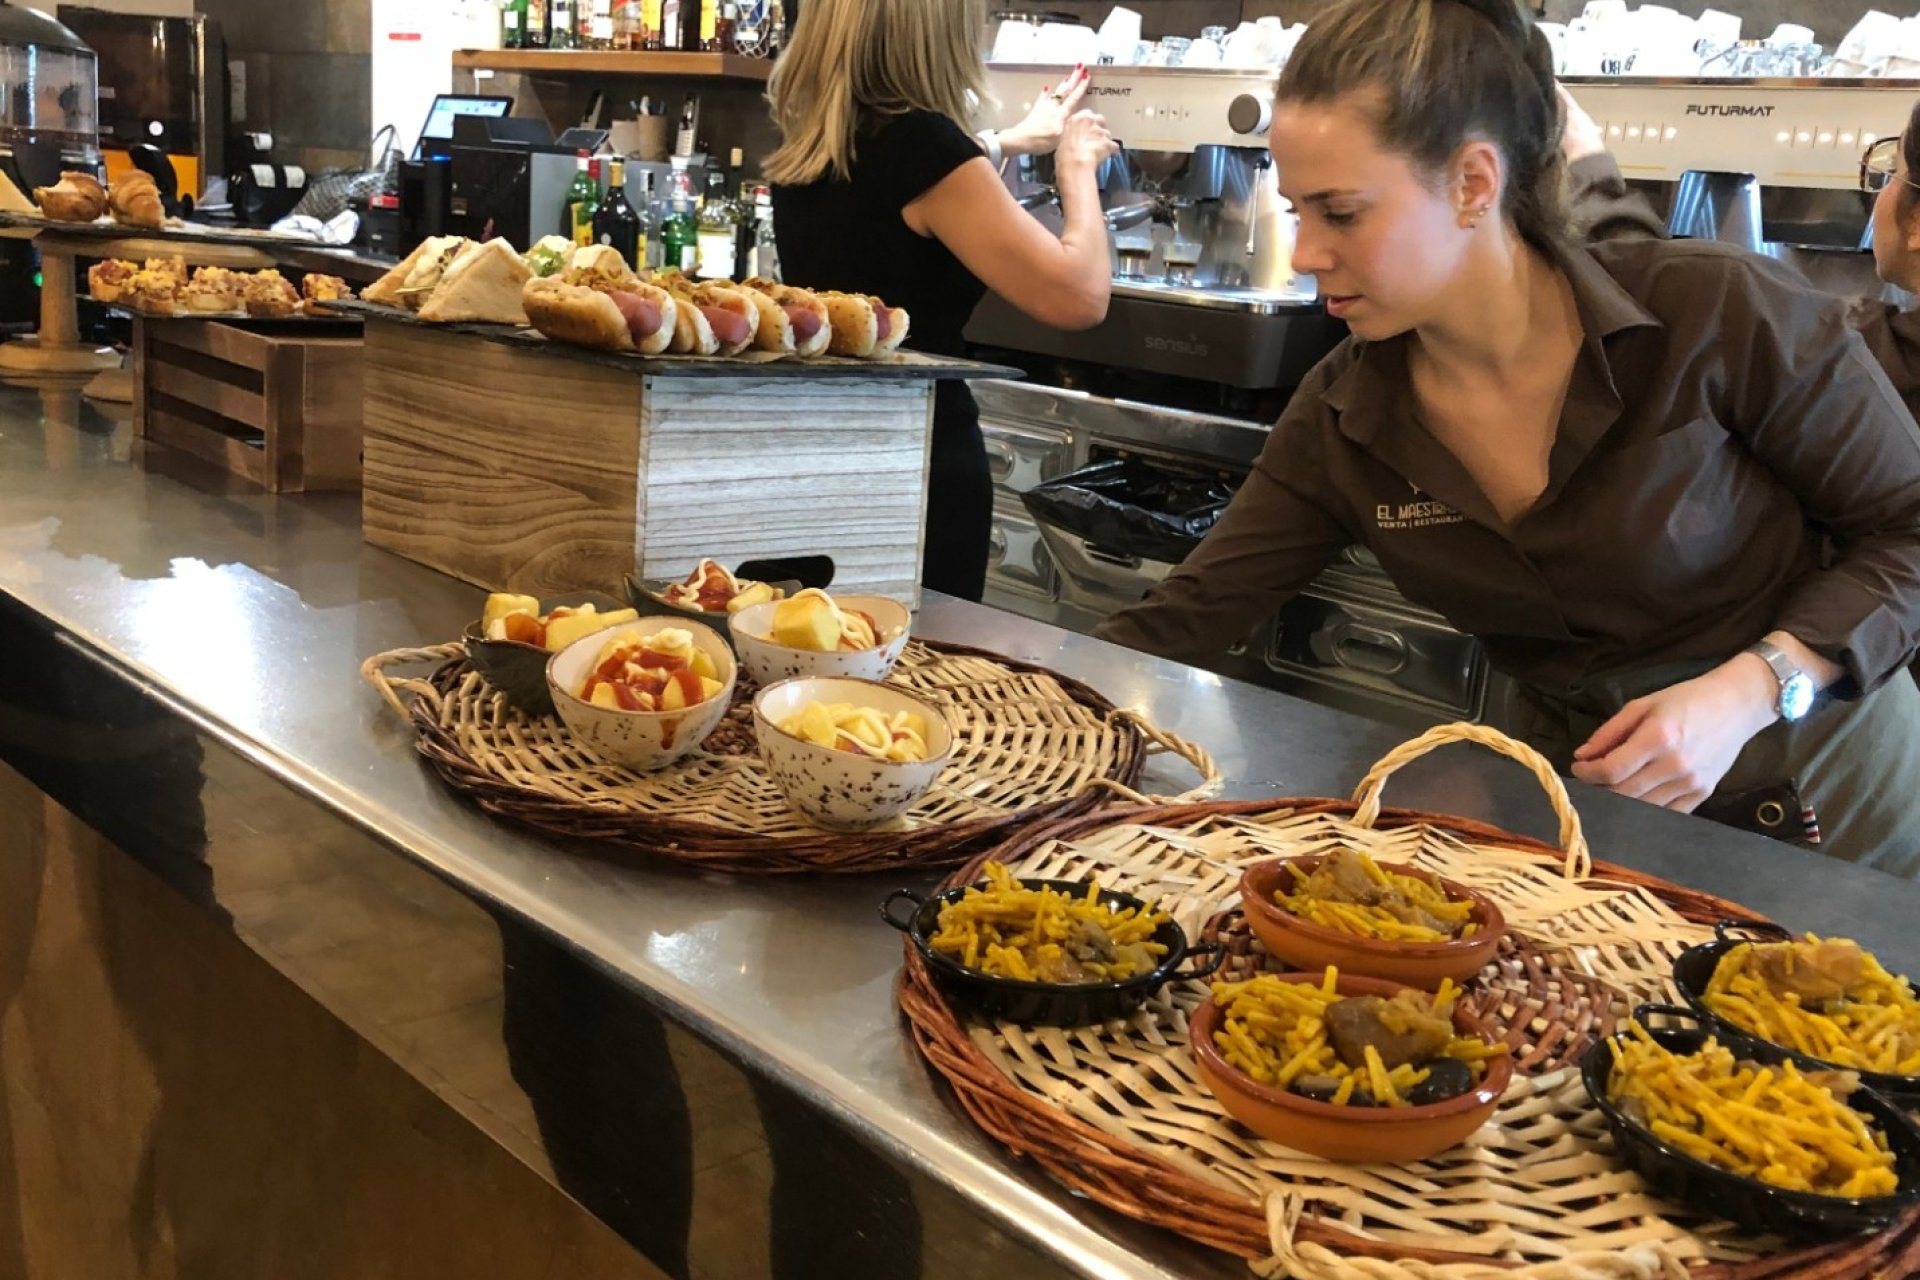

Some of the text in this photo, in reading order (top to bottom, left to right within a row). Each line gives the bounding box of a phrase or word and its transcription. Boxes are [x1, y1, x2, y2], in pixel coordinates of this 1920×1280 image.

[1086, 86, 1132, 96] UTURMAT
[1686, 104, 1776, 117] FUTURMAT
[1144, 333, 1208, 357] sensius
[1377, 502, 1457, 520] EL MAESTR
